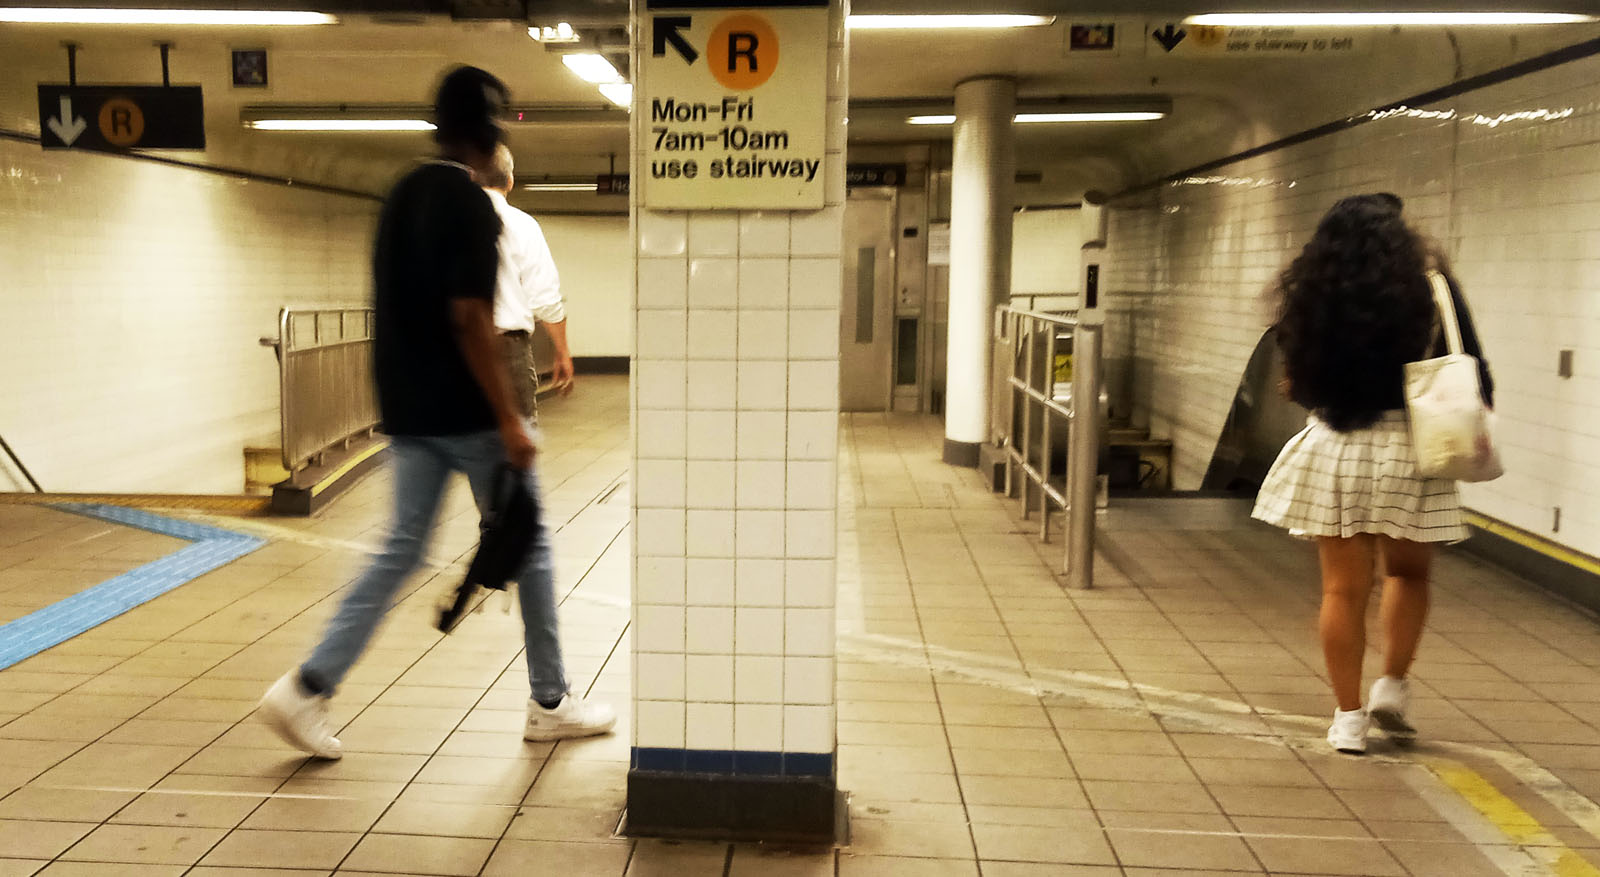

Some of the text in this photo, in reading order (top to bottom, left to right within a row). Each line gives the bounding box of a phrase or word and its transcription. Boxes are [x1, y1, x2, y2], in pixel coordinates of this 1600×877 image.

[727, 30, 759, 73] R
[1227, 37, 1353, 52] use stairway to left
[652, 96, 754, 122] Mon-Fri
[112, 109, 132, 136] R
[652, 126, 789, 151] 7am-10am
[652, 153, 820, 182] use stairway
